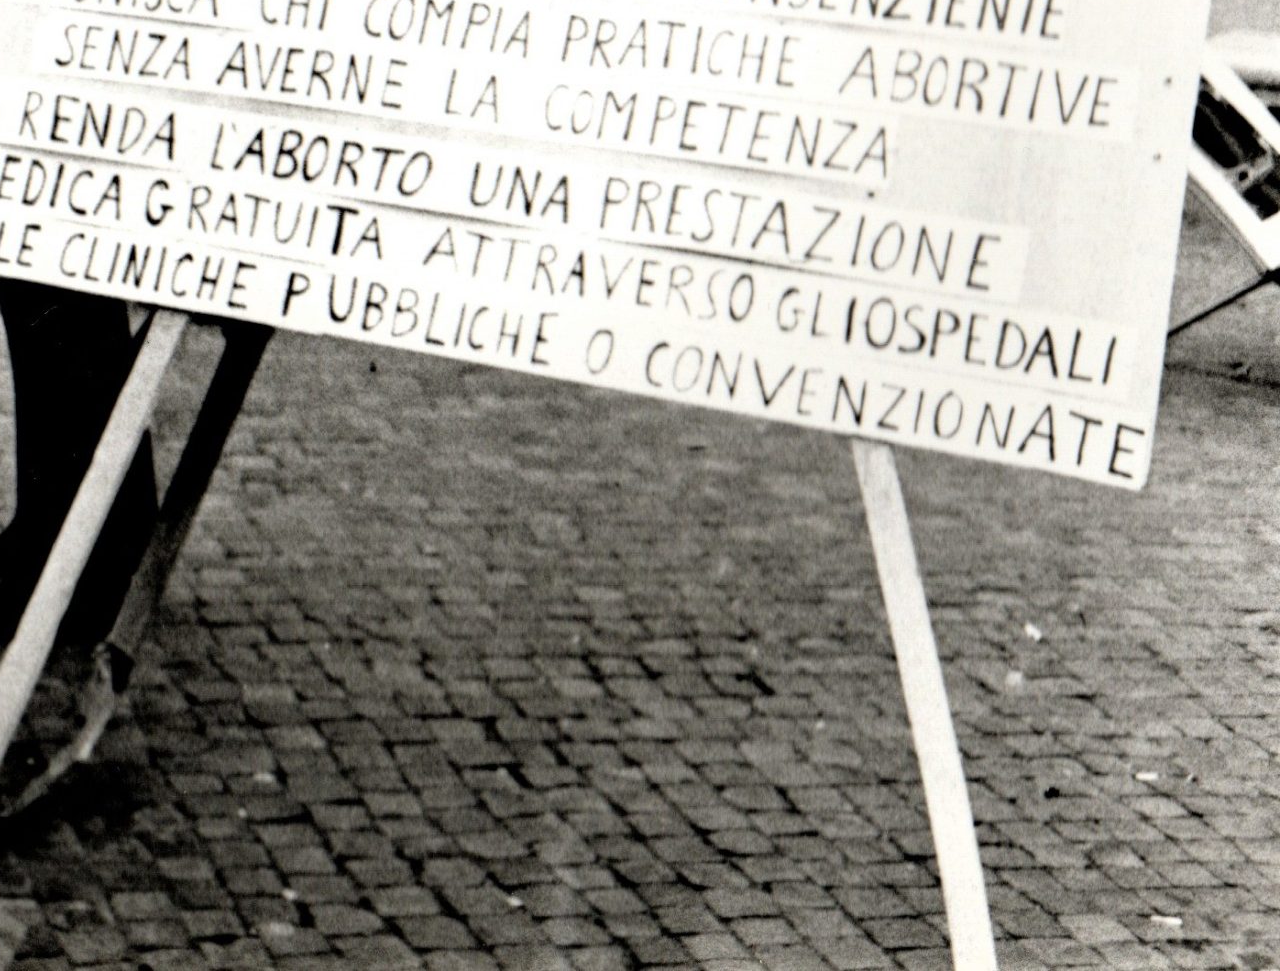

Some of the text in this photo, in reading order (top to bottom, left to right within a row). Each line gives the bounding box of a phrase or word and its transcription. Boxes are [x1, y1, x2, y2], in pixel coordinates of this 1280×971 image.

[55, 23, 889, 179] SENZA AVERNE LA COMPETENZA
[561, 14, 801, 87] PRATICHE
[838, 46, 1118, 128] ABORTIVE
[18, 91, 177, 161] RENDA
[210, 121, 435, 197] L'ABORTO
[469, 161, 570, 224] UNA
[599, 176, 1002, 292] PRESTAZIONE
[145, 179, 383, 261] GRATUITA
[422, 226, 755, 321] ATTRAVERSO
[59, 231, 258, 310] CLINICHE
[281, 271, 559, 365] PUBBLICHE
[584, 328, 615, 375] O
[645, 342, 1146, 479] CONVENZIONATE
